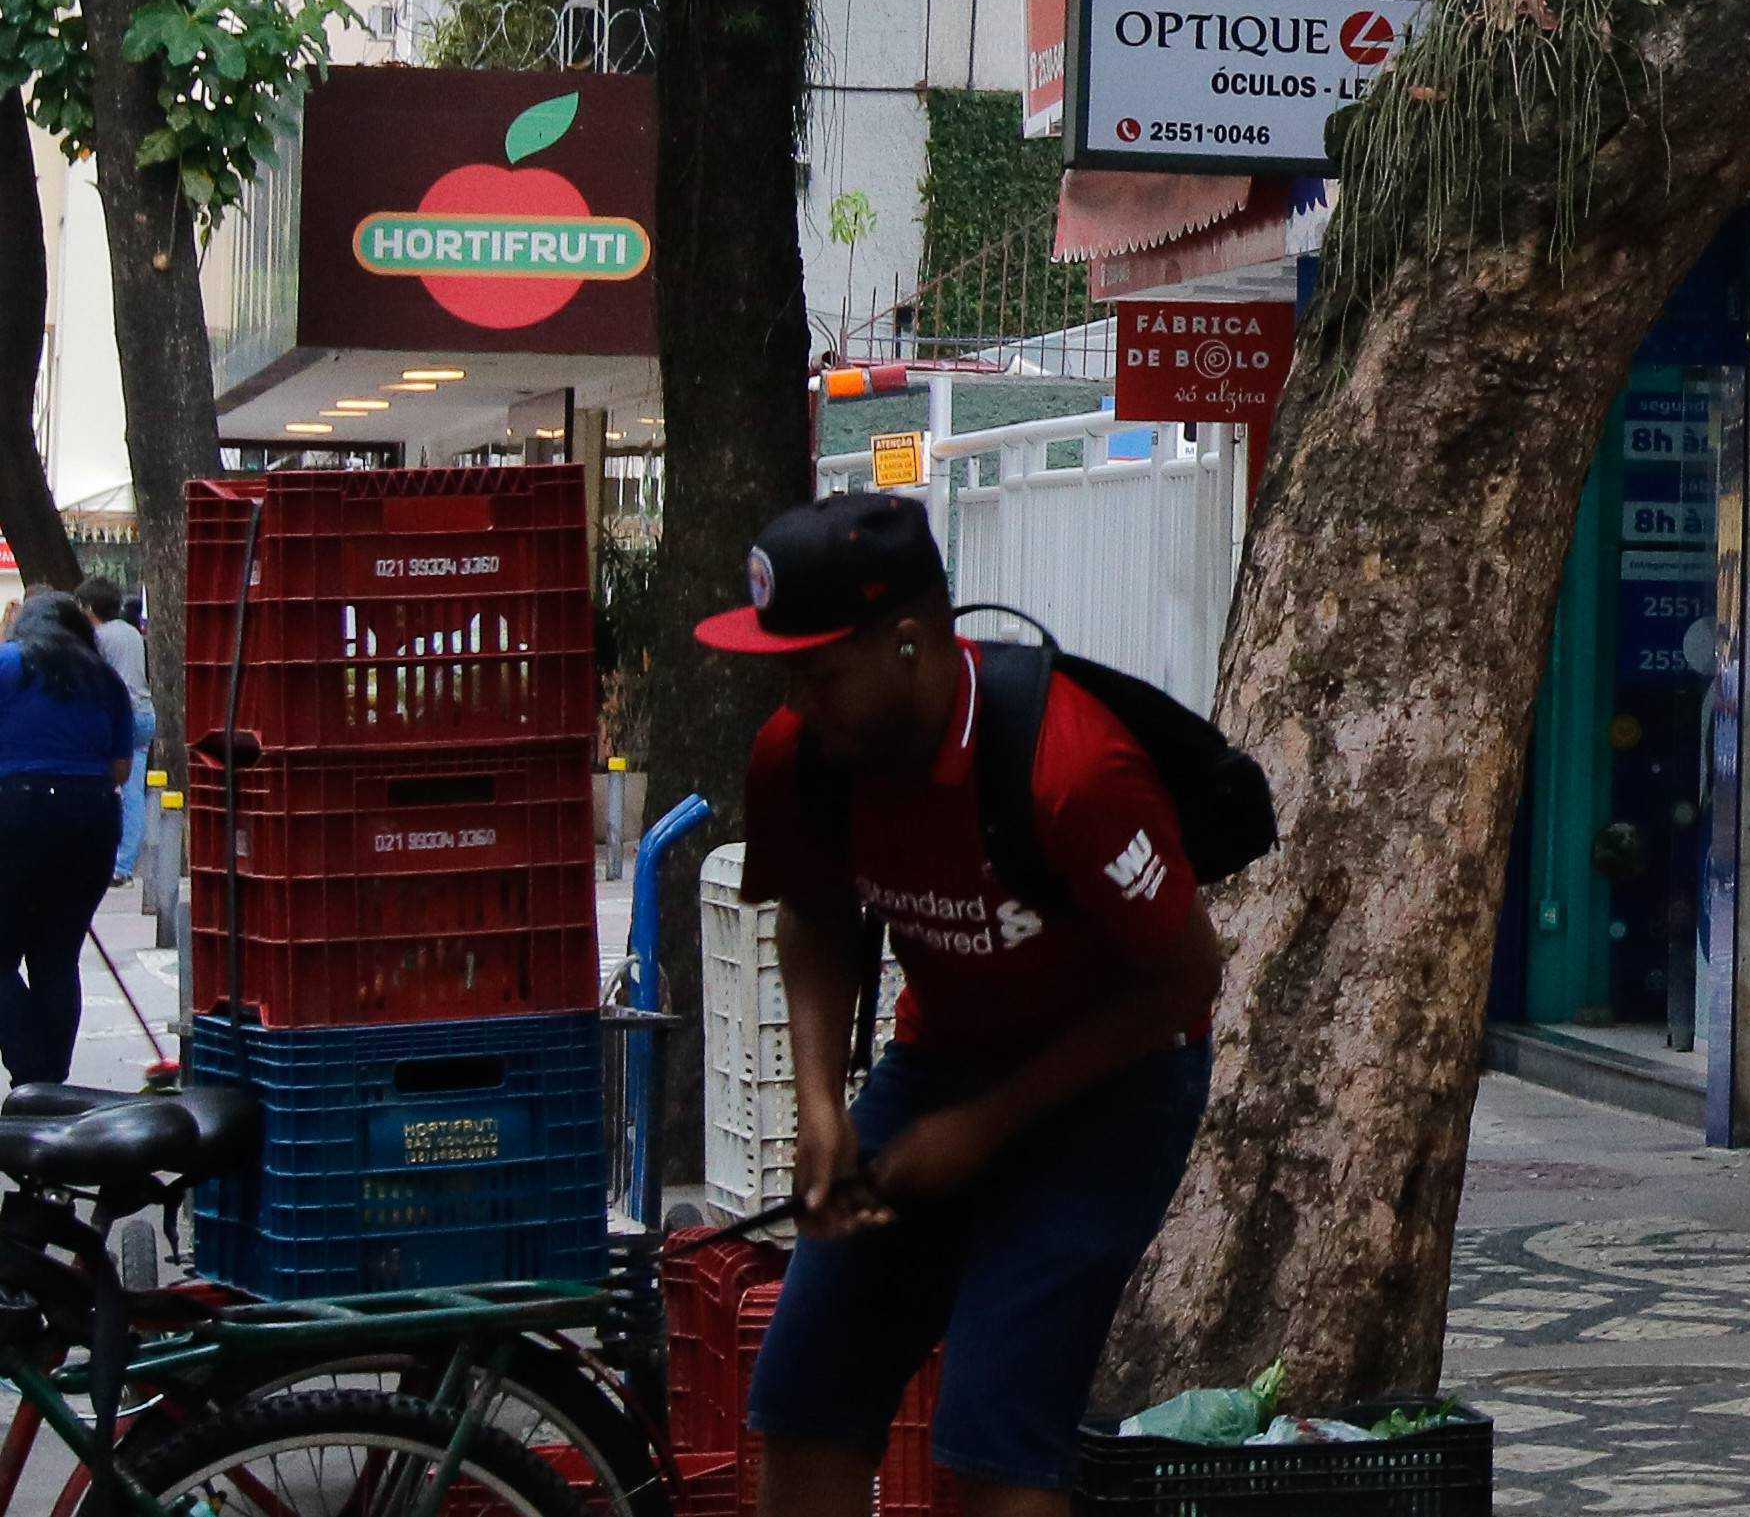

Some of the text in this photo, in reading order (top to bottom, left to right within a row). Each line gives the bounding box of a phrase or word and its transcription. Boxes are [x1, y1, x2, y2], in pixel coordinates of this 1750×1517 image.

[1115, 10, 1331, 58] OPTIQUE
[1211, 67, 1317, 98] ÓCULOS
[1150, 121, 1271, 145] 2551-0046
[373, 227, 627, 266] HORTIFRUTI
[1137, 309, 1262, 337] FÁBRICA
[1127, 340, 1270, 379] DE BOLO
[1206, 380, 1267, 414] alzira
[1631, 428, 1673, 452] 8h
[1634, 509, 1676, 534] 8h
[376, 558, 404, 577] 021
[1639, 651, 1690, 671] 255
[375, 833, 404, 852] 021
